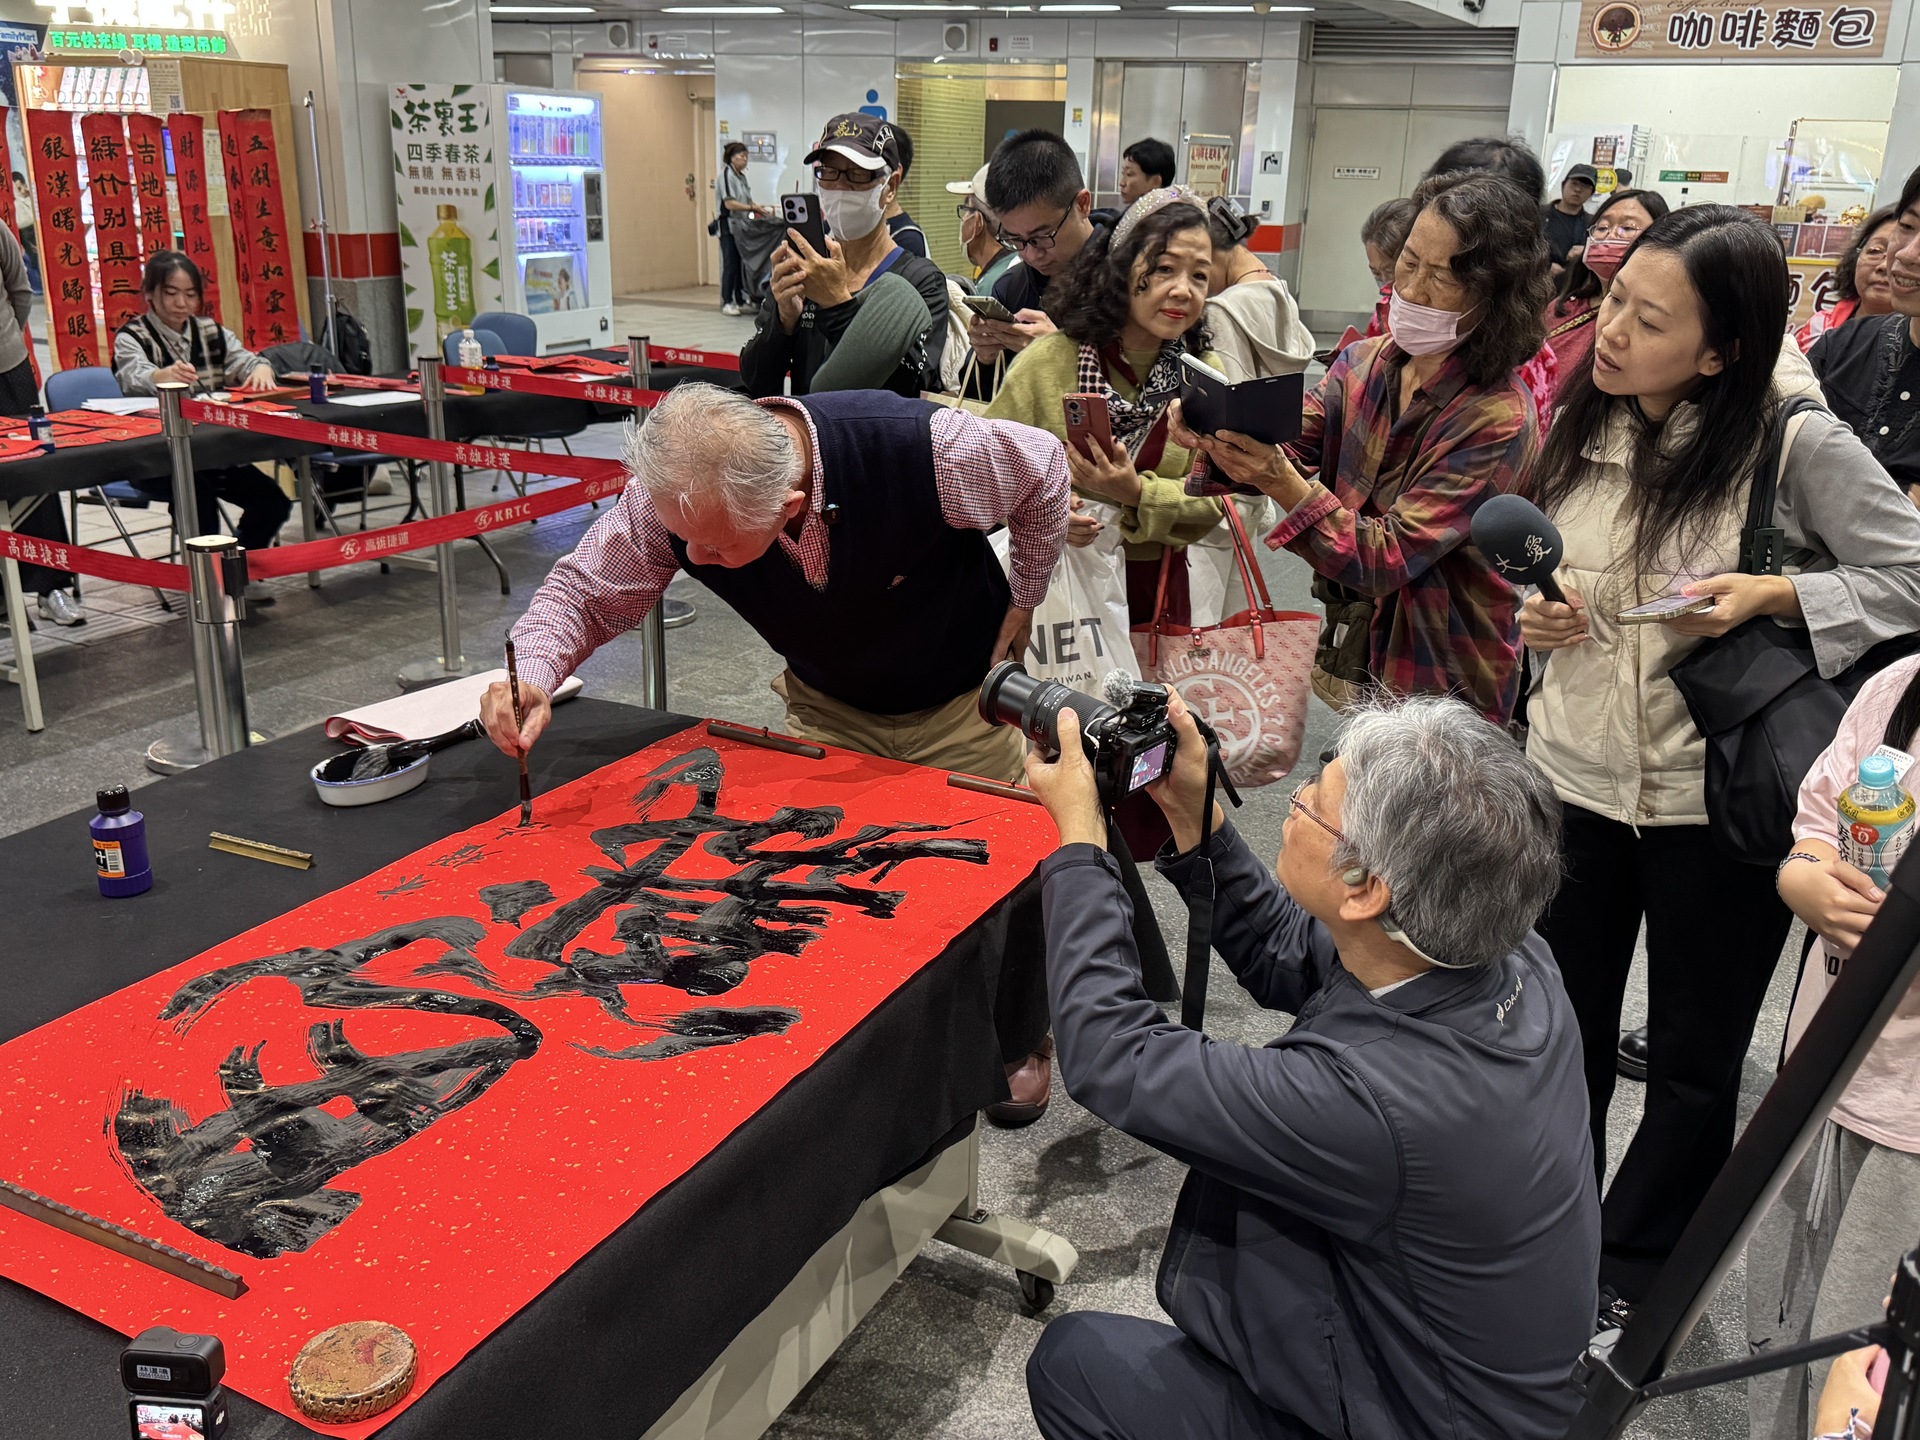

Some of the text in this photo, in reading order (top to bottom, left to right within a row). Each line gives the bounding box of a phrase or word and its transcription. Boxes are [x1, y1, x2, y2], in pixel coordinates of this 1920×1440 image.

[1668, 6, 1876, 49] 咖啡麵包
[131, 33, 163, 51] 耳機
[407, 143, 480, 164] 四季春茶
[441, 166, 481, 182] 無香料
[467, 370, 512, 390] 高雄捷運
[583, 383, 633, 404] 高雄捷運
[203, 405, 249, 430] 高雄捷運
[328, 426, 379, 450] 高雄捷運
[455, 446, 512, 470] 高雄捷運
[495, 502, 531, 522] KRTC
[8, 536, 70, 570] 高雄捷運
[1207, 649, 1281, 710] ANGELES
